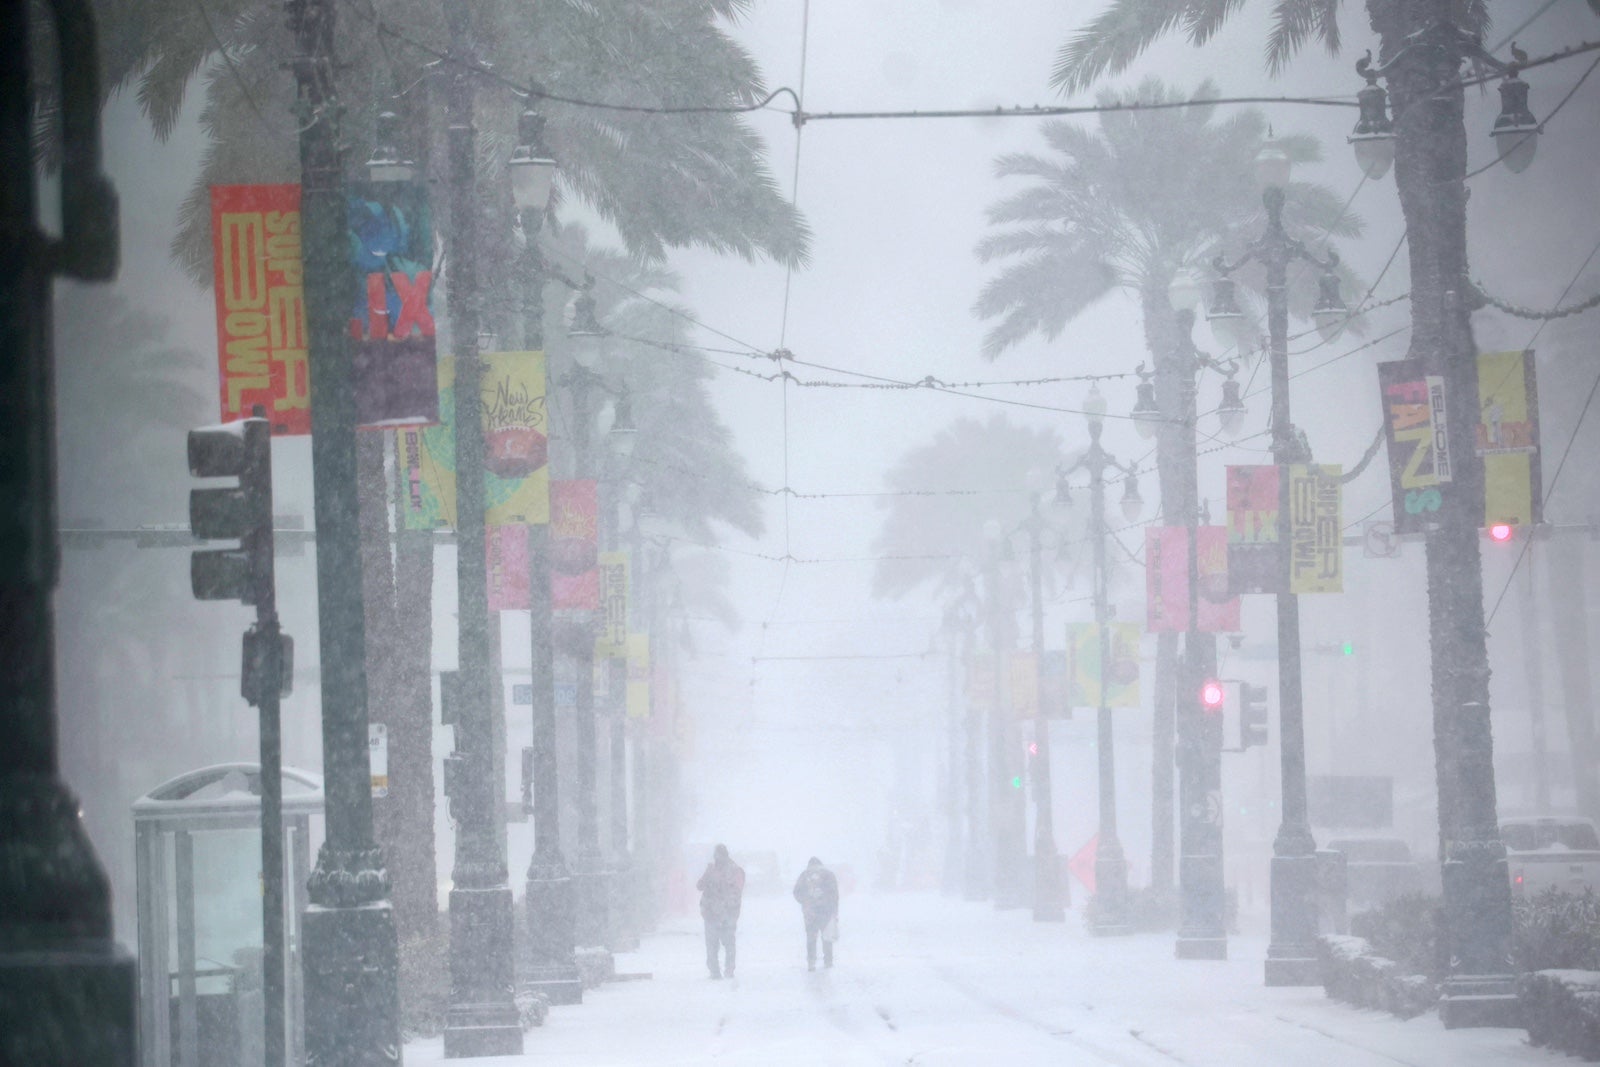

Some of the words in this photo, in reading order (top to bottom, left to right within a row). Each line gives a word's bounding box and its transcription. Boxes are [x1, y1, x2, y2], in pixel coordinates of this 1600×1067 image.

[221, 211, 271, 413] BOWL
[265, 211, 309, 412] SUPER
[350, 271, 436, 341] IX
[491, 375, 528, 414] New
[1386, 380, 1442, 514] FANS
[1226, 510, 1280, 543] LIX
[1295, 476, 1316, 580] BOWL
